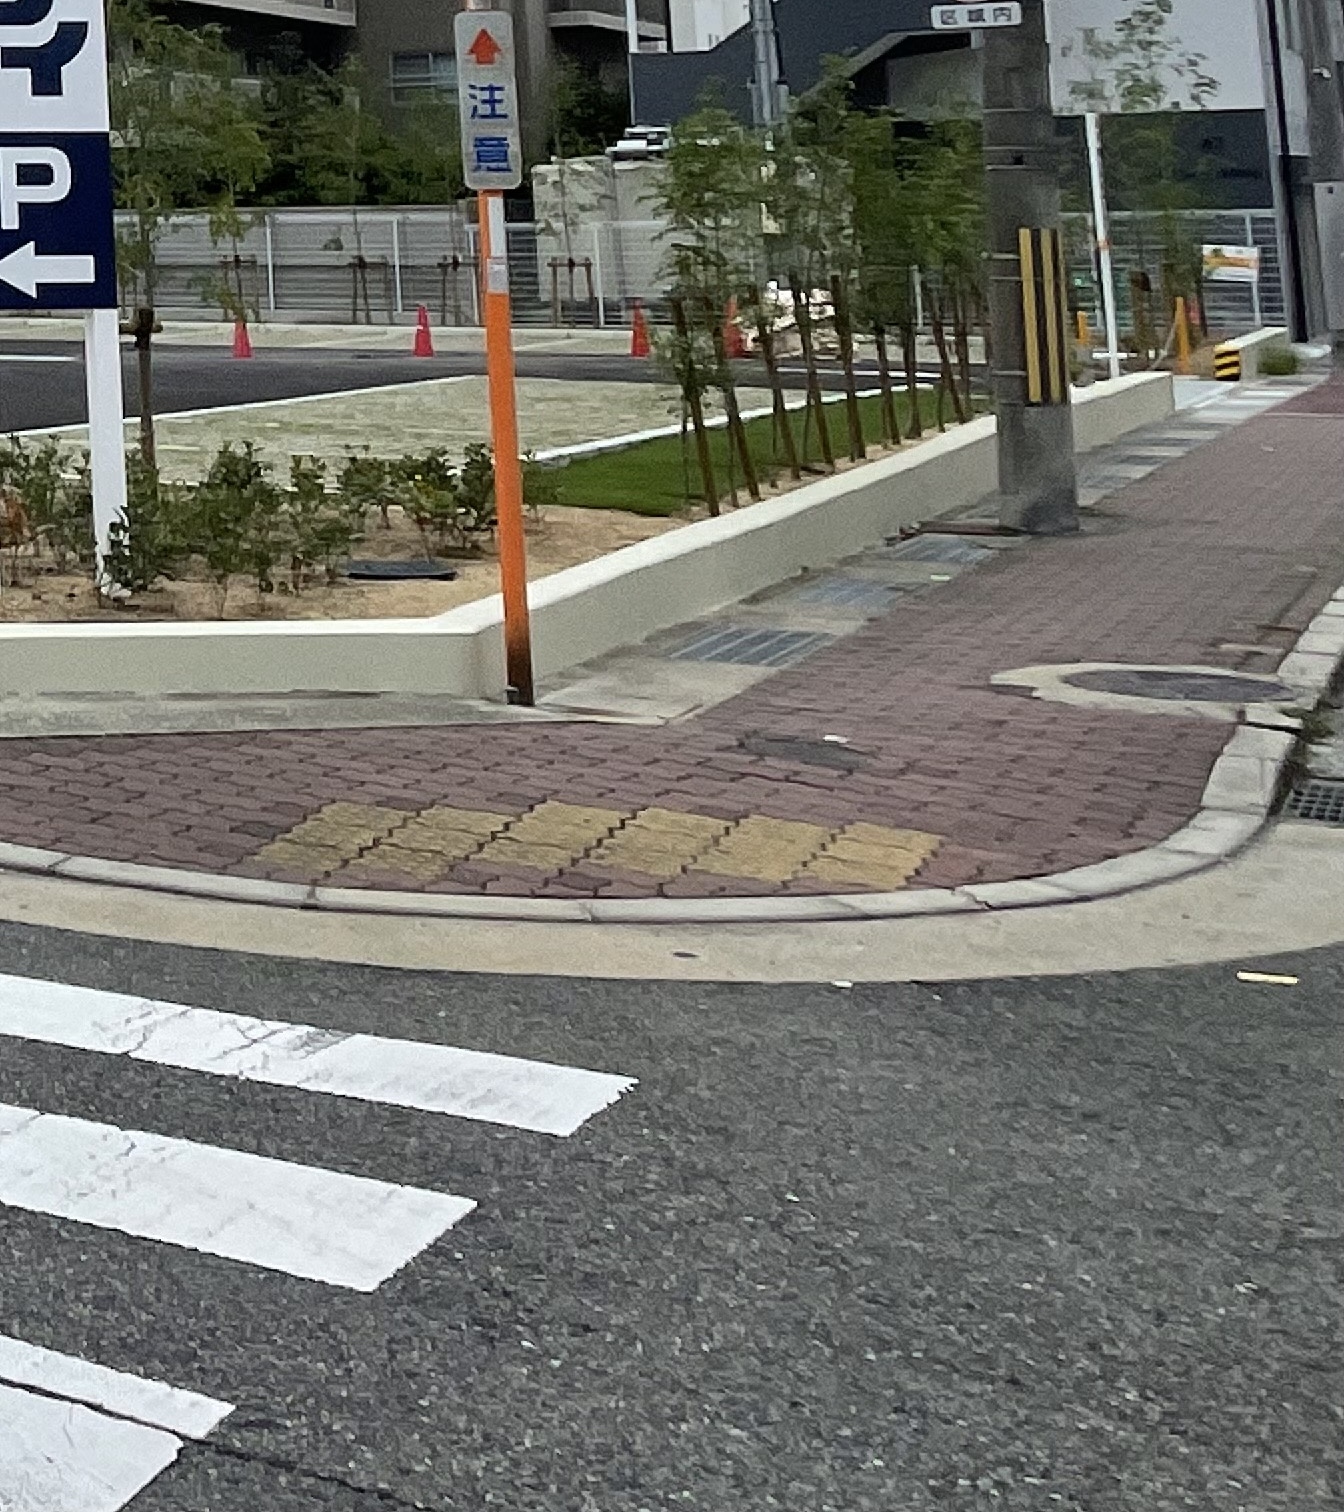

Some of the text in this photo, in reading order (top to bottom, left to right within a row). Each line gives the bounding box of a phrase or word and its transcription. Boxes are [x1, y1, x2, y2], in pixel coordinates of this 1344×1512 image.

[940, 7, 1013, 25] 区域内
[468, 83, 513, 174] 注意
